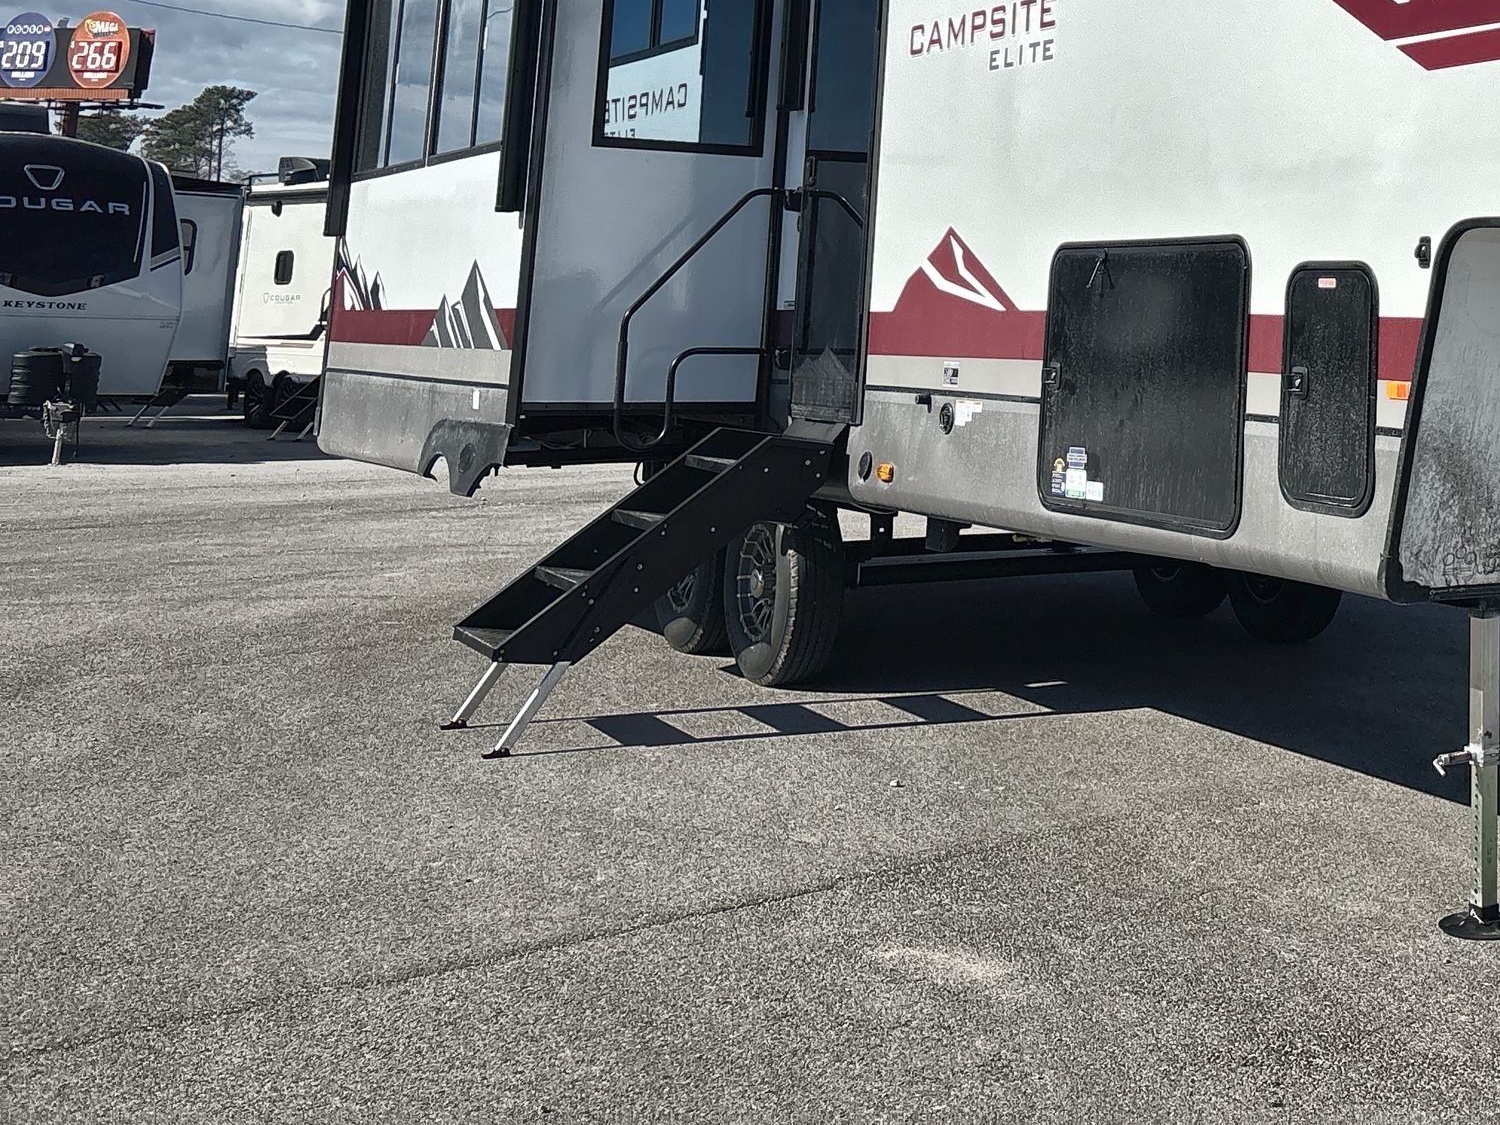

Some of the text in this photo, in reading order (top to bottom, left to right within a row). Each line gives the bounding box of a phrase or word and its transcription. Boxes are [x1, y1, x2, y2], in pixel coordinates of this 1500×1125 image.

[989, 39, 1054, 71] ELITE
[0, 195, 130, 215] OUGAR
[2, 299, 88, 311] KEYSTONE
